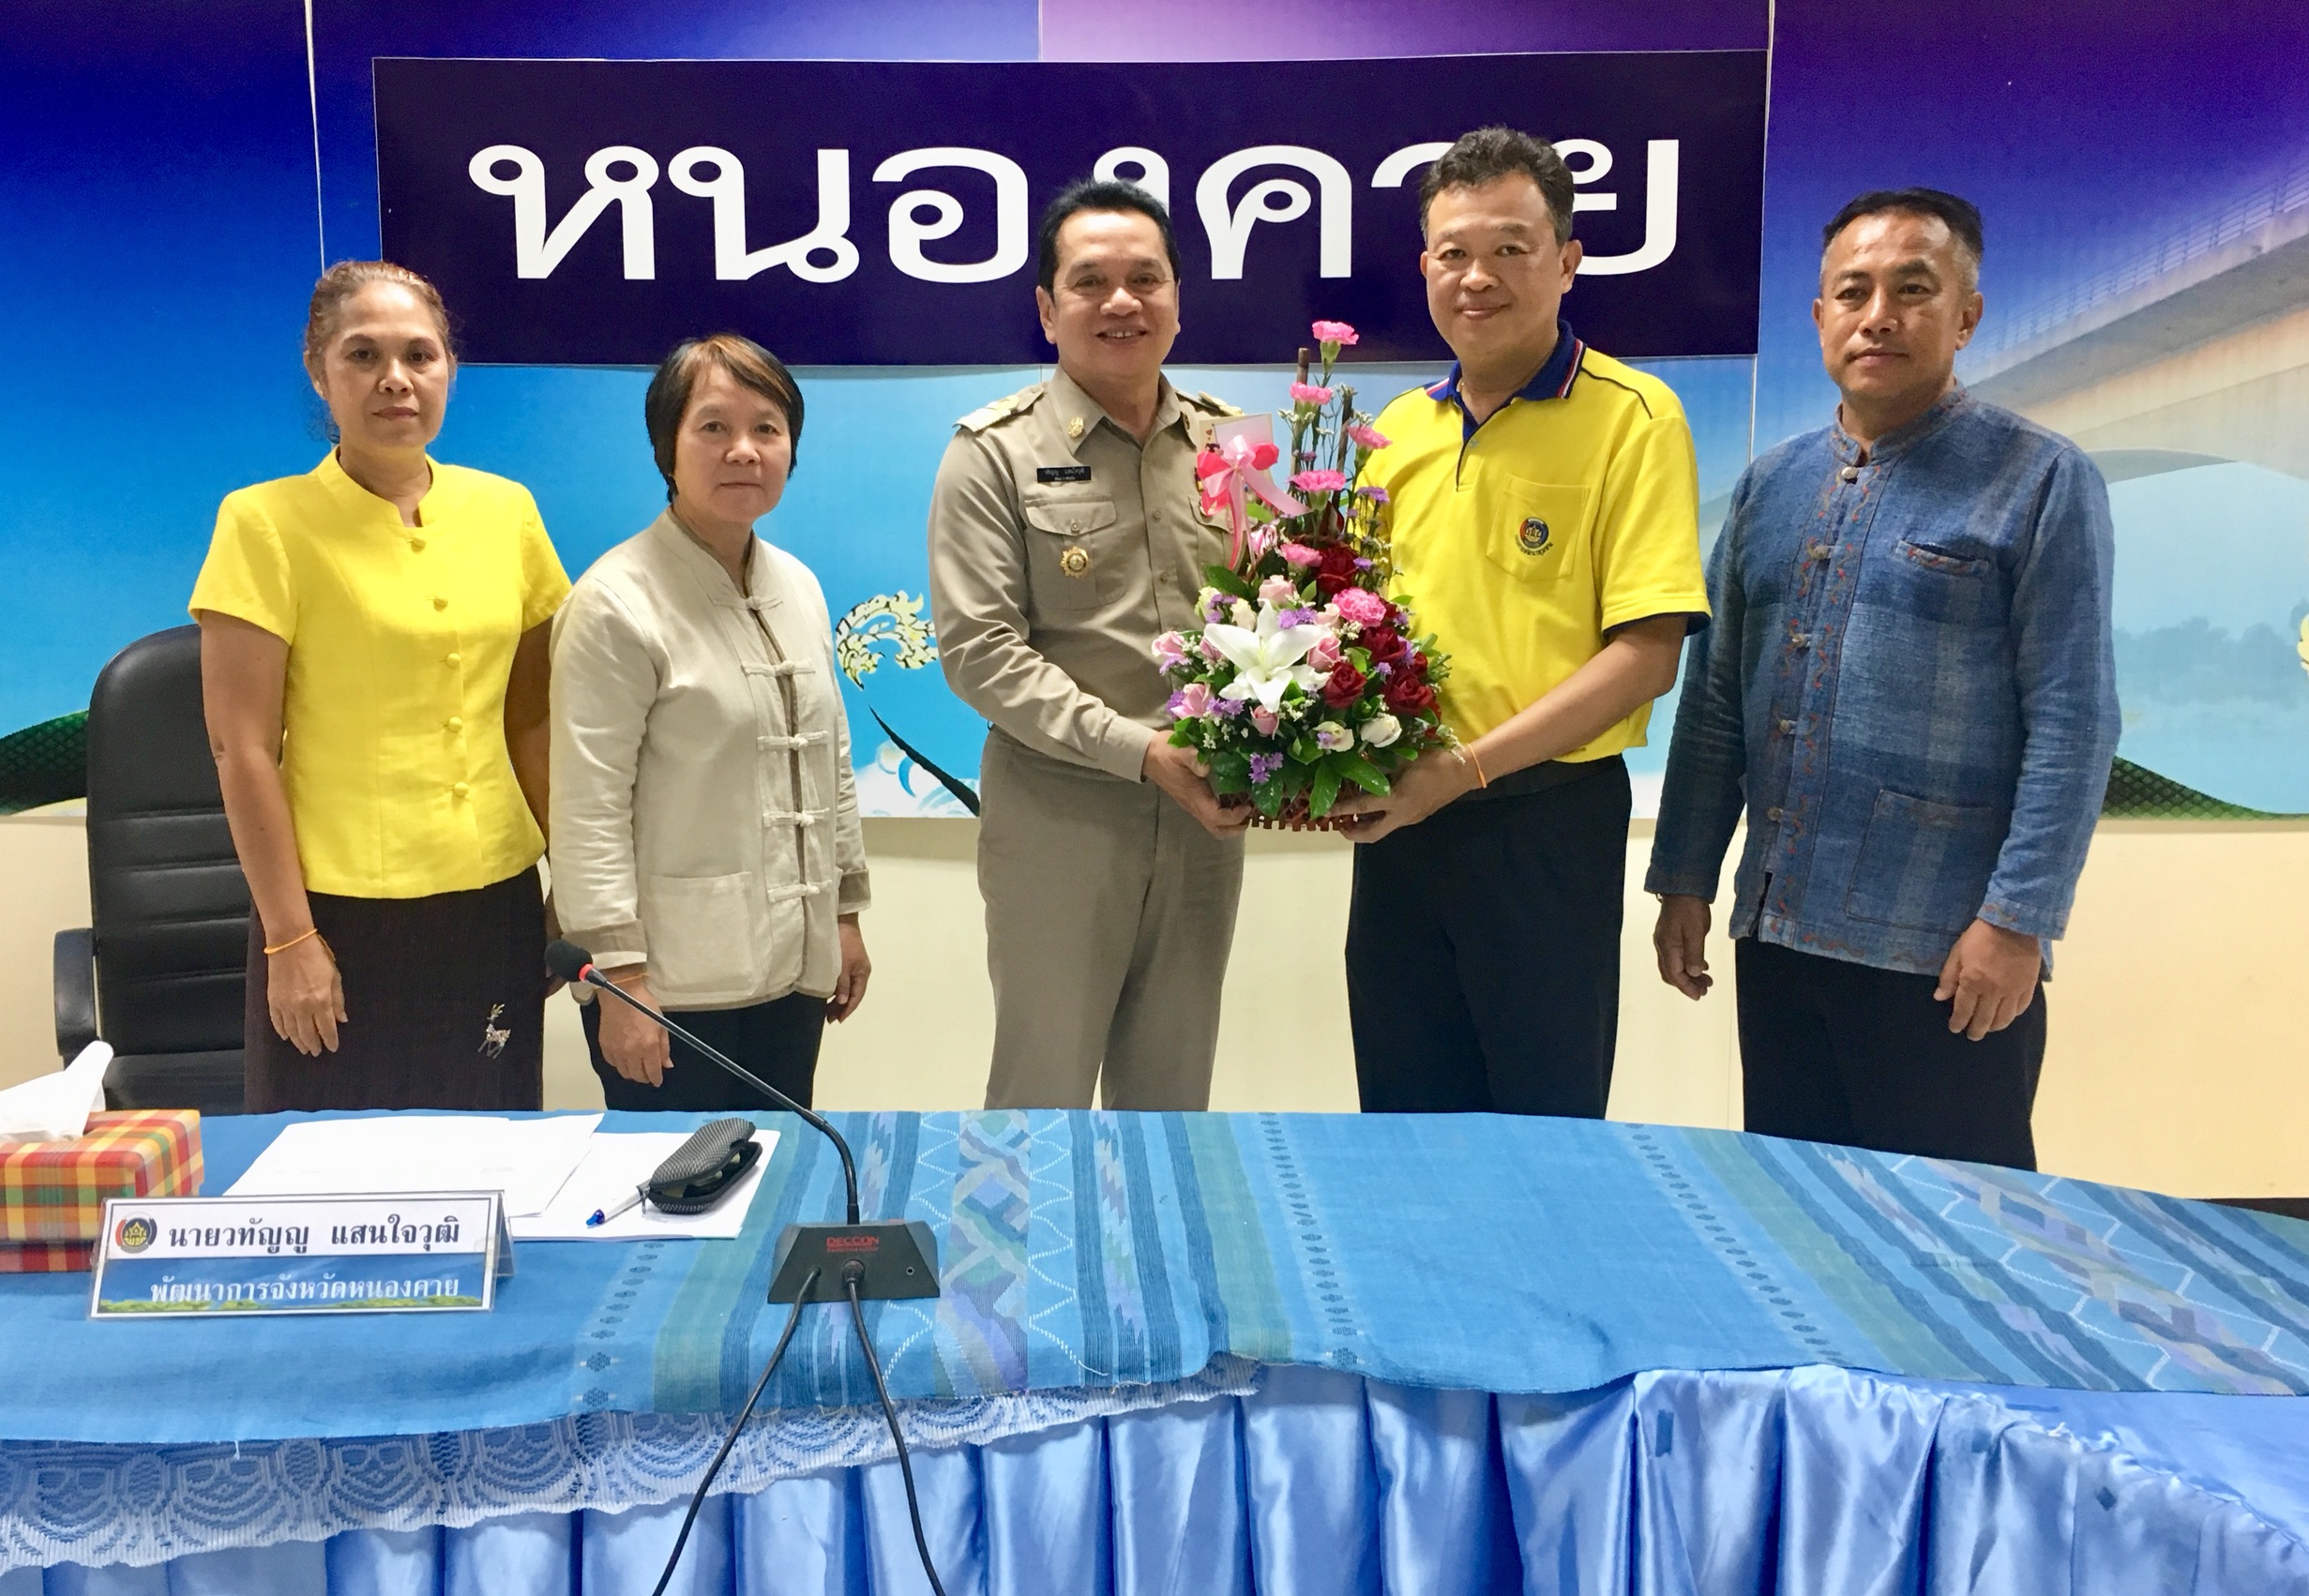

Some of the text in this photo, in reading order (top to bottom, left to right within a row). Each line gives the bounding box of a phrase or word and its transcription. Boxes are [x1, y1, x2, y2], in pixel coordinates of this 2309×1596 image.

[169, 1212, 460, 1254] นายวทัญญู แสนใจวุฒิ
[826, 1236, 879, 1247] DECCON
[150, 1272, 460, 1302] พัฒนาการจังหวัดหนองคาย
